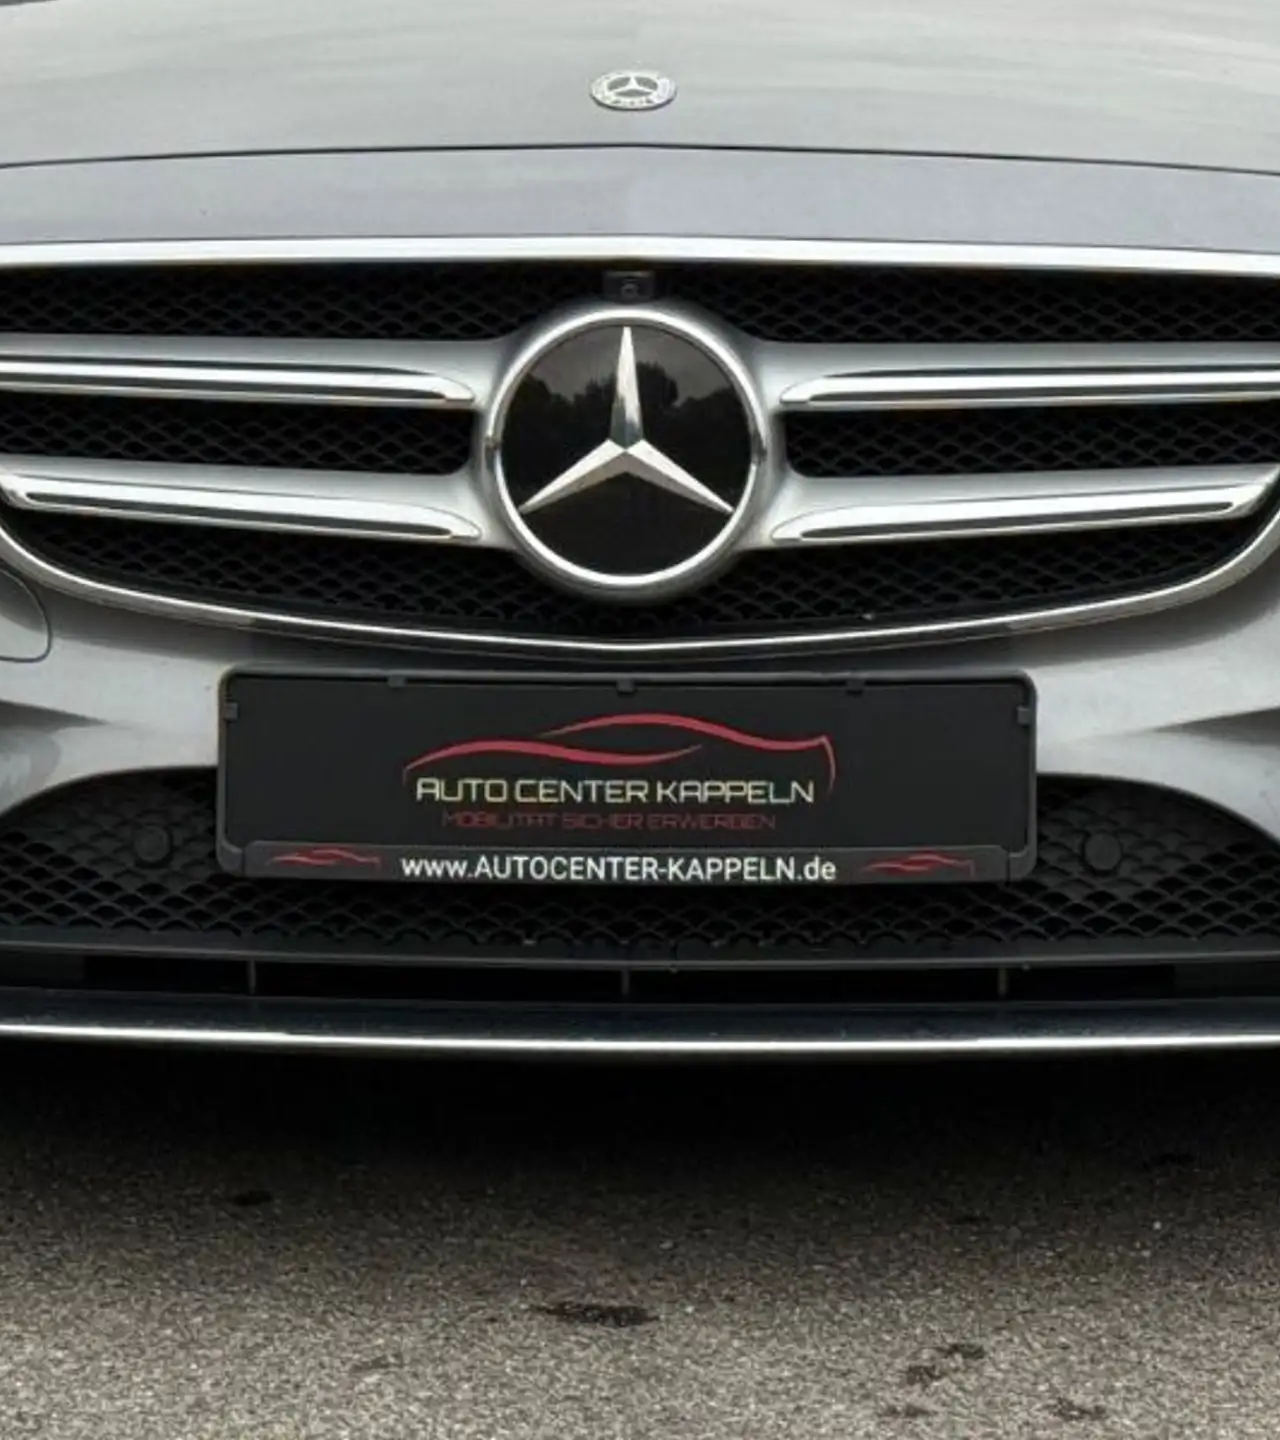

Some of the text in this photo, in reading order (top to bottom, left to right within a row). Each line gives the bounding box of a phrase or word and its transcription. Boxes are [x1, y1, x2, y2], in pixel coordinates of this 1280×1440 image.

[416, 777, 815, 804] AUTO CENTER KAPPELN
[401, 853, 837, 881] www.AUTOCENTER-KAPPELN.de
